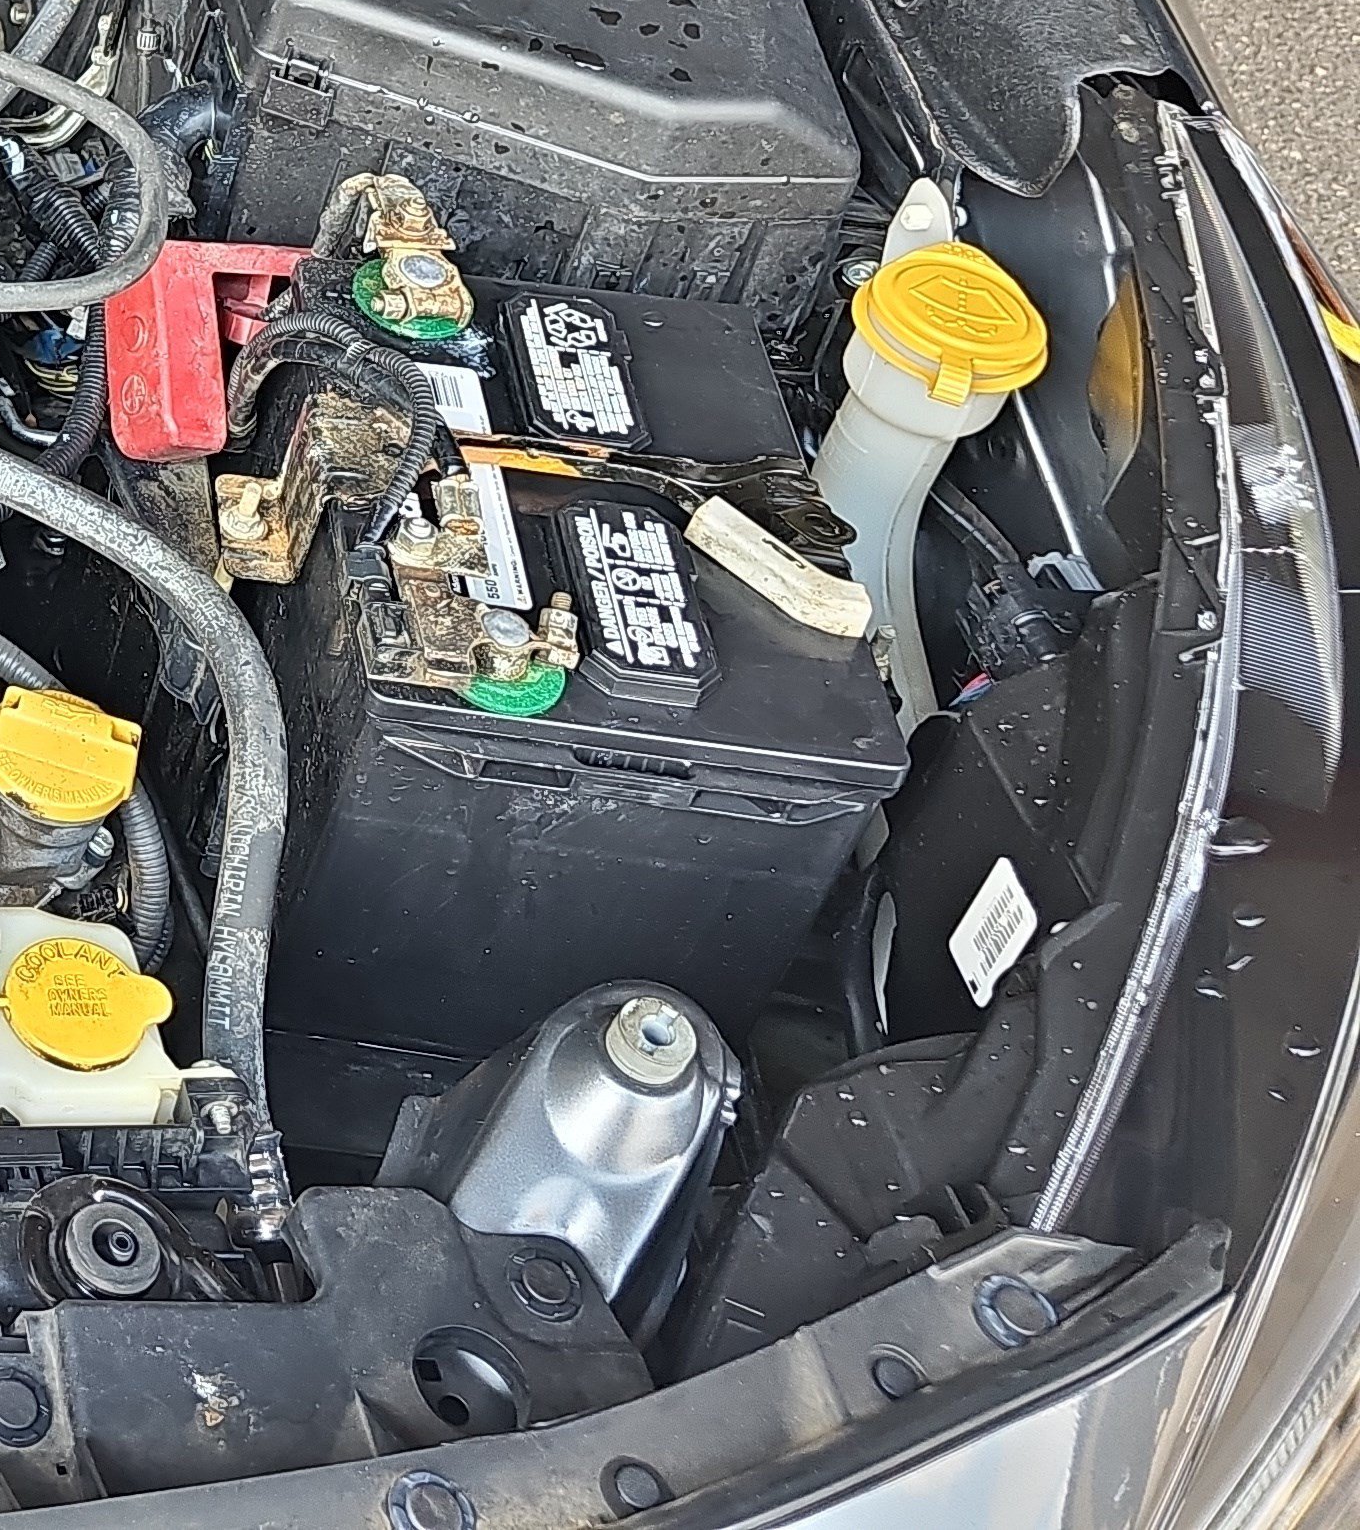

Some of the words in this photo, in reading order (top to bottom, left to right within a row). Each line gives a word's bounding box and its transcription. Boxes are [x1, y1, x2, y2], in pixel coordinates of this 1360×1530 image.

[574, 515, 603, 569] POISON
[484, 579, 501, 600] 550
[591, 579, 621, 639] DANGER
[65, 782, 113, 804] MANUAL
[15, 942, 130, 983] COOLANT
[54, 974, 85, 987] SEE
[50, 1002, 112, 1017] MANUAL
